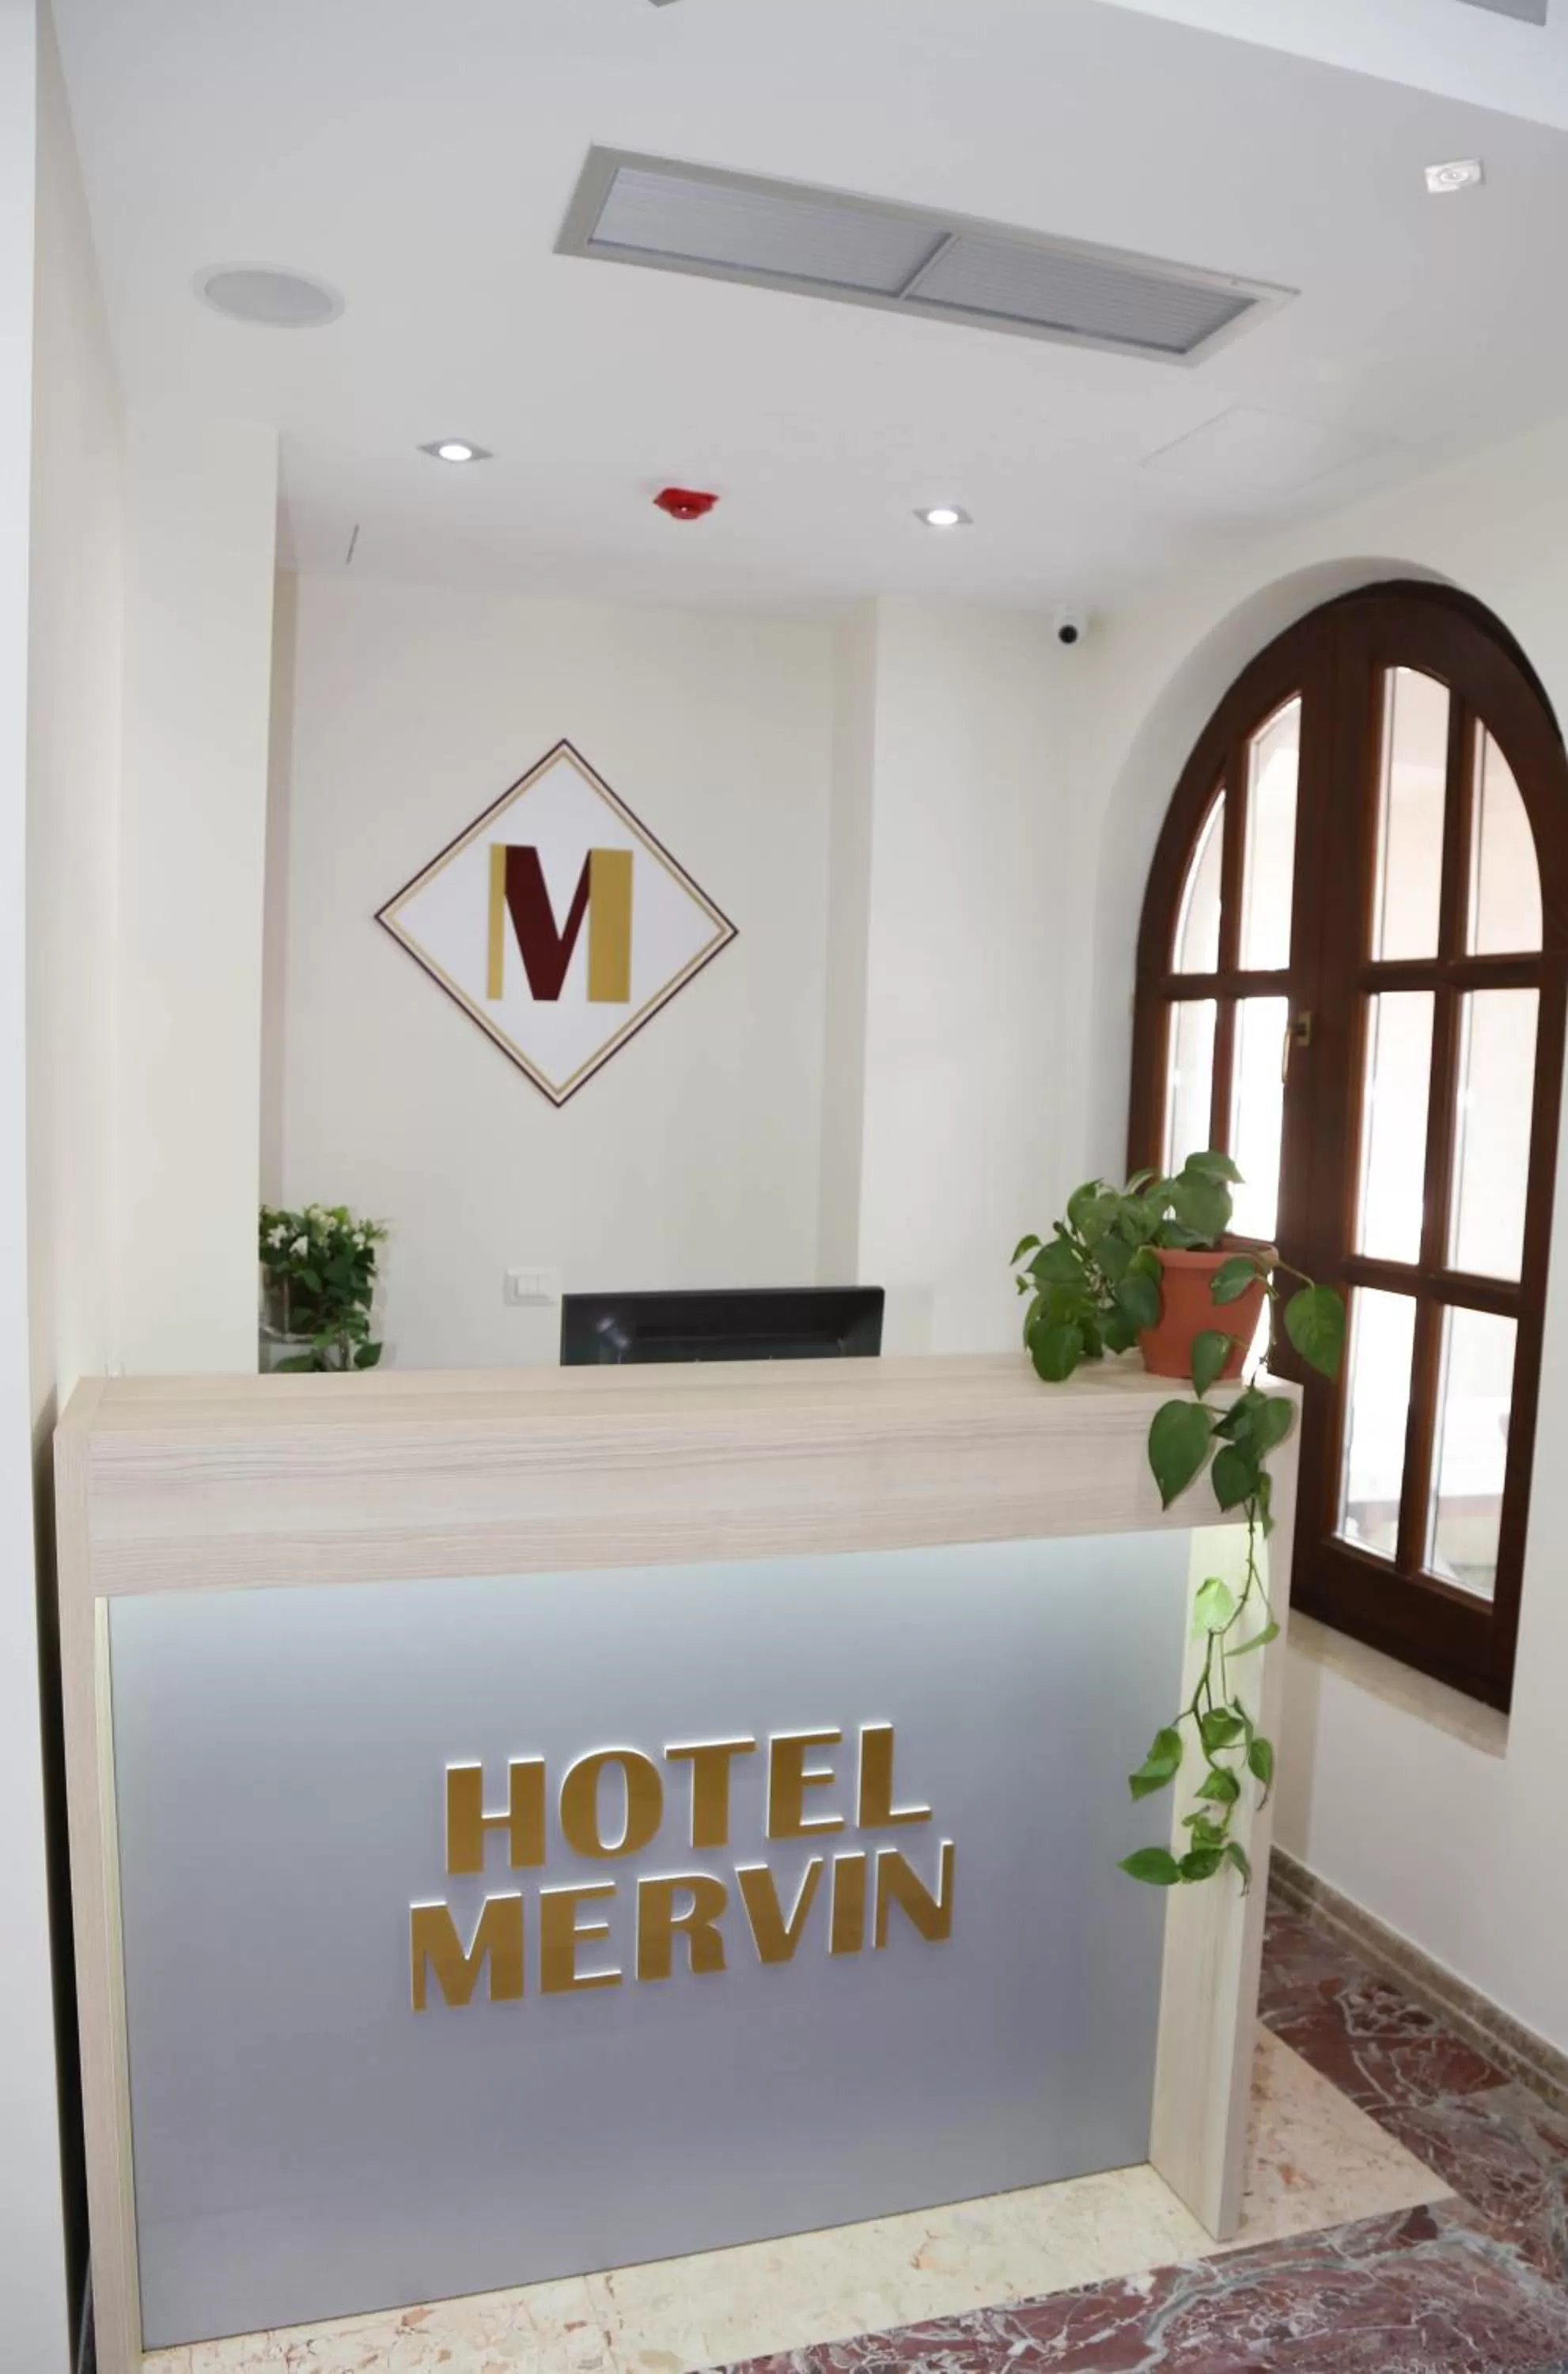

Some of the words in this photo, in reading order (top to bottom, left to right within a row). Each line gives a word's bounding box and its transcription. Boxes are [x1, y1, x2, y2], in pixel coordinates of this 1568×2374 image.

[487, 844, 632, 1002] M
[445, 1722, 932, 1875] HOTEL
[409, 1838, 954, 2012] MERVIN
